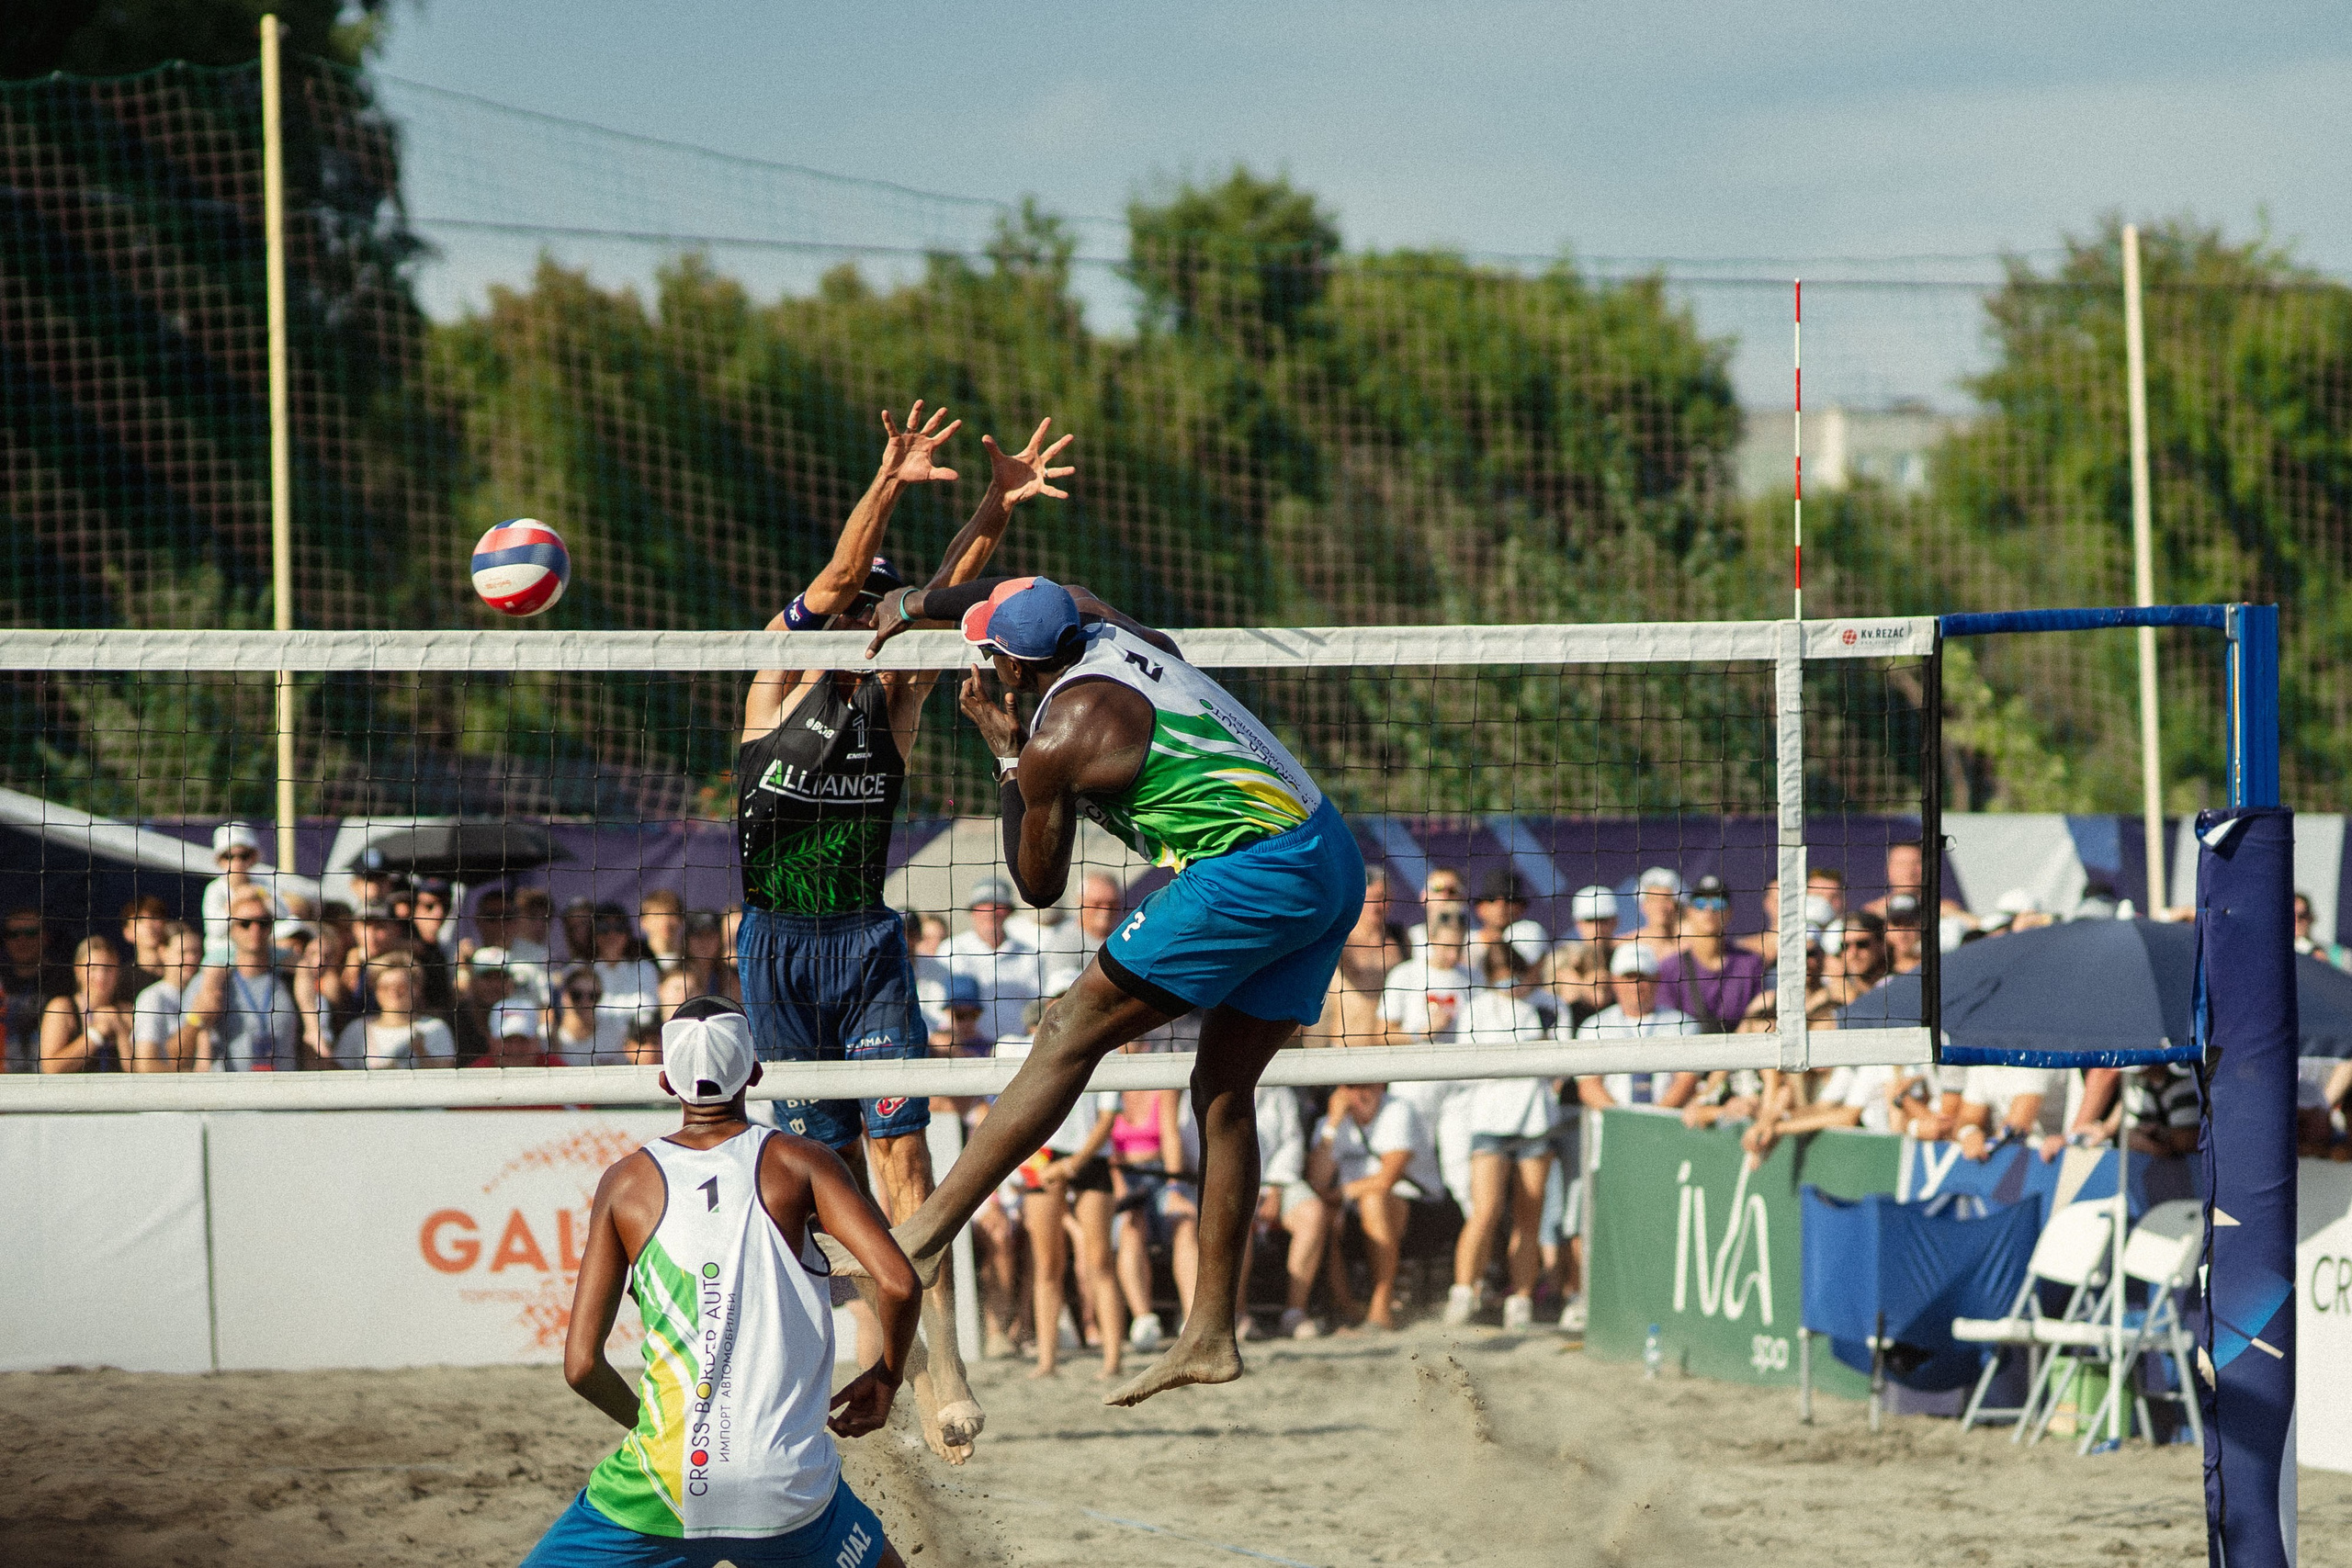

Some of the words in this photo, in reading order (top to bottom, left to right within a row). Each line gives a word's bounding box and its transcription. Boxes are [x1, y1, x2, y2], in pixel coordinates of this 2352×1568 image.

[852, 713, 865, 749] 1
[759, 759, 887, 797] ALLIANCE
[1121, 911, 1147, 942] 2
[695, 1173, 720, 1214] 1
[688, 1422, 710, 1497] CROSS
[702, 1261, 722, 1320] AUTO
[718, 1404, 731, 1462] ИМПОРТ
